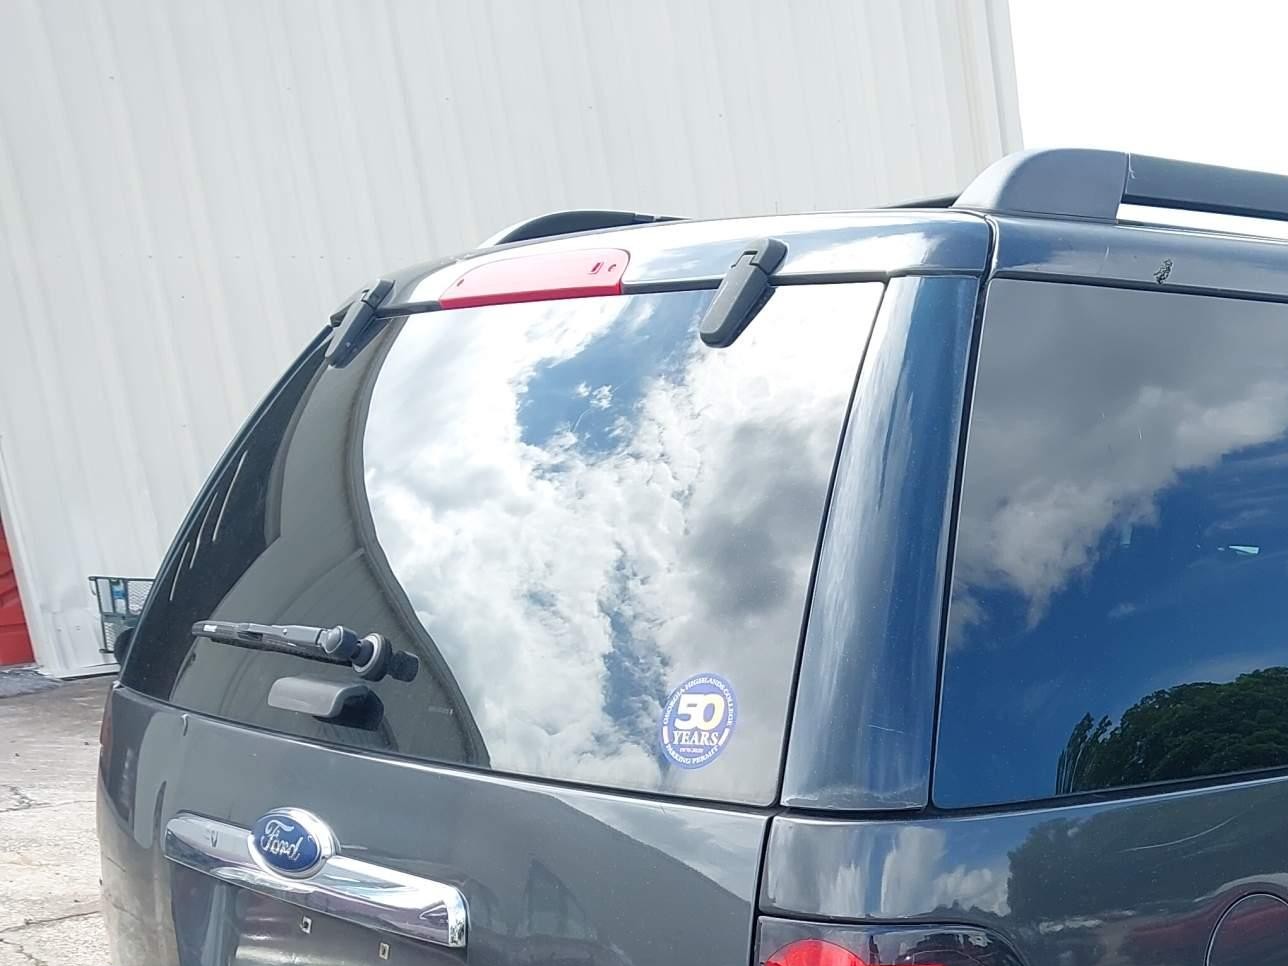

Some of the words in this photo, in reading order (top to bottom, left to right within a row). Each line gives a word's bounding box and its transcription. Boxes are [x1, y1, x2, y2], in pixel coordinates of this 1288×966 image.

[685, 677, 725, 690] HIGHLANDS
[674, 693, 725, 731] 50
[672, 730, 719, 746] YEARS
[692, 745, 719, 765] PERMIT
[260, 819, 304, 862] Ford
